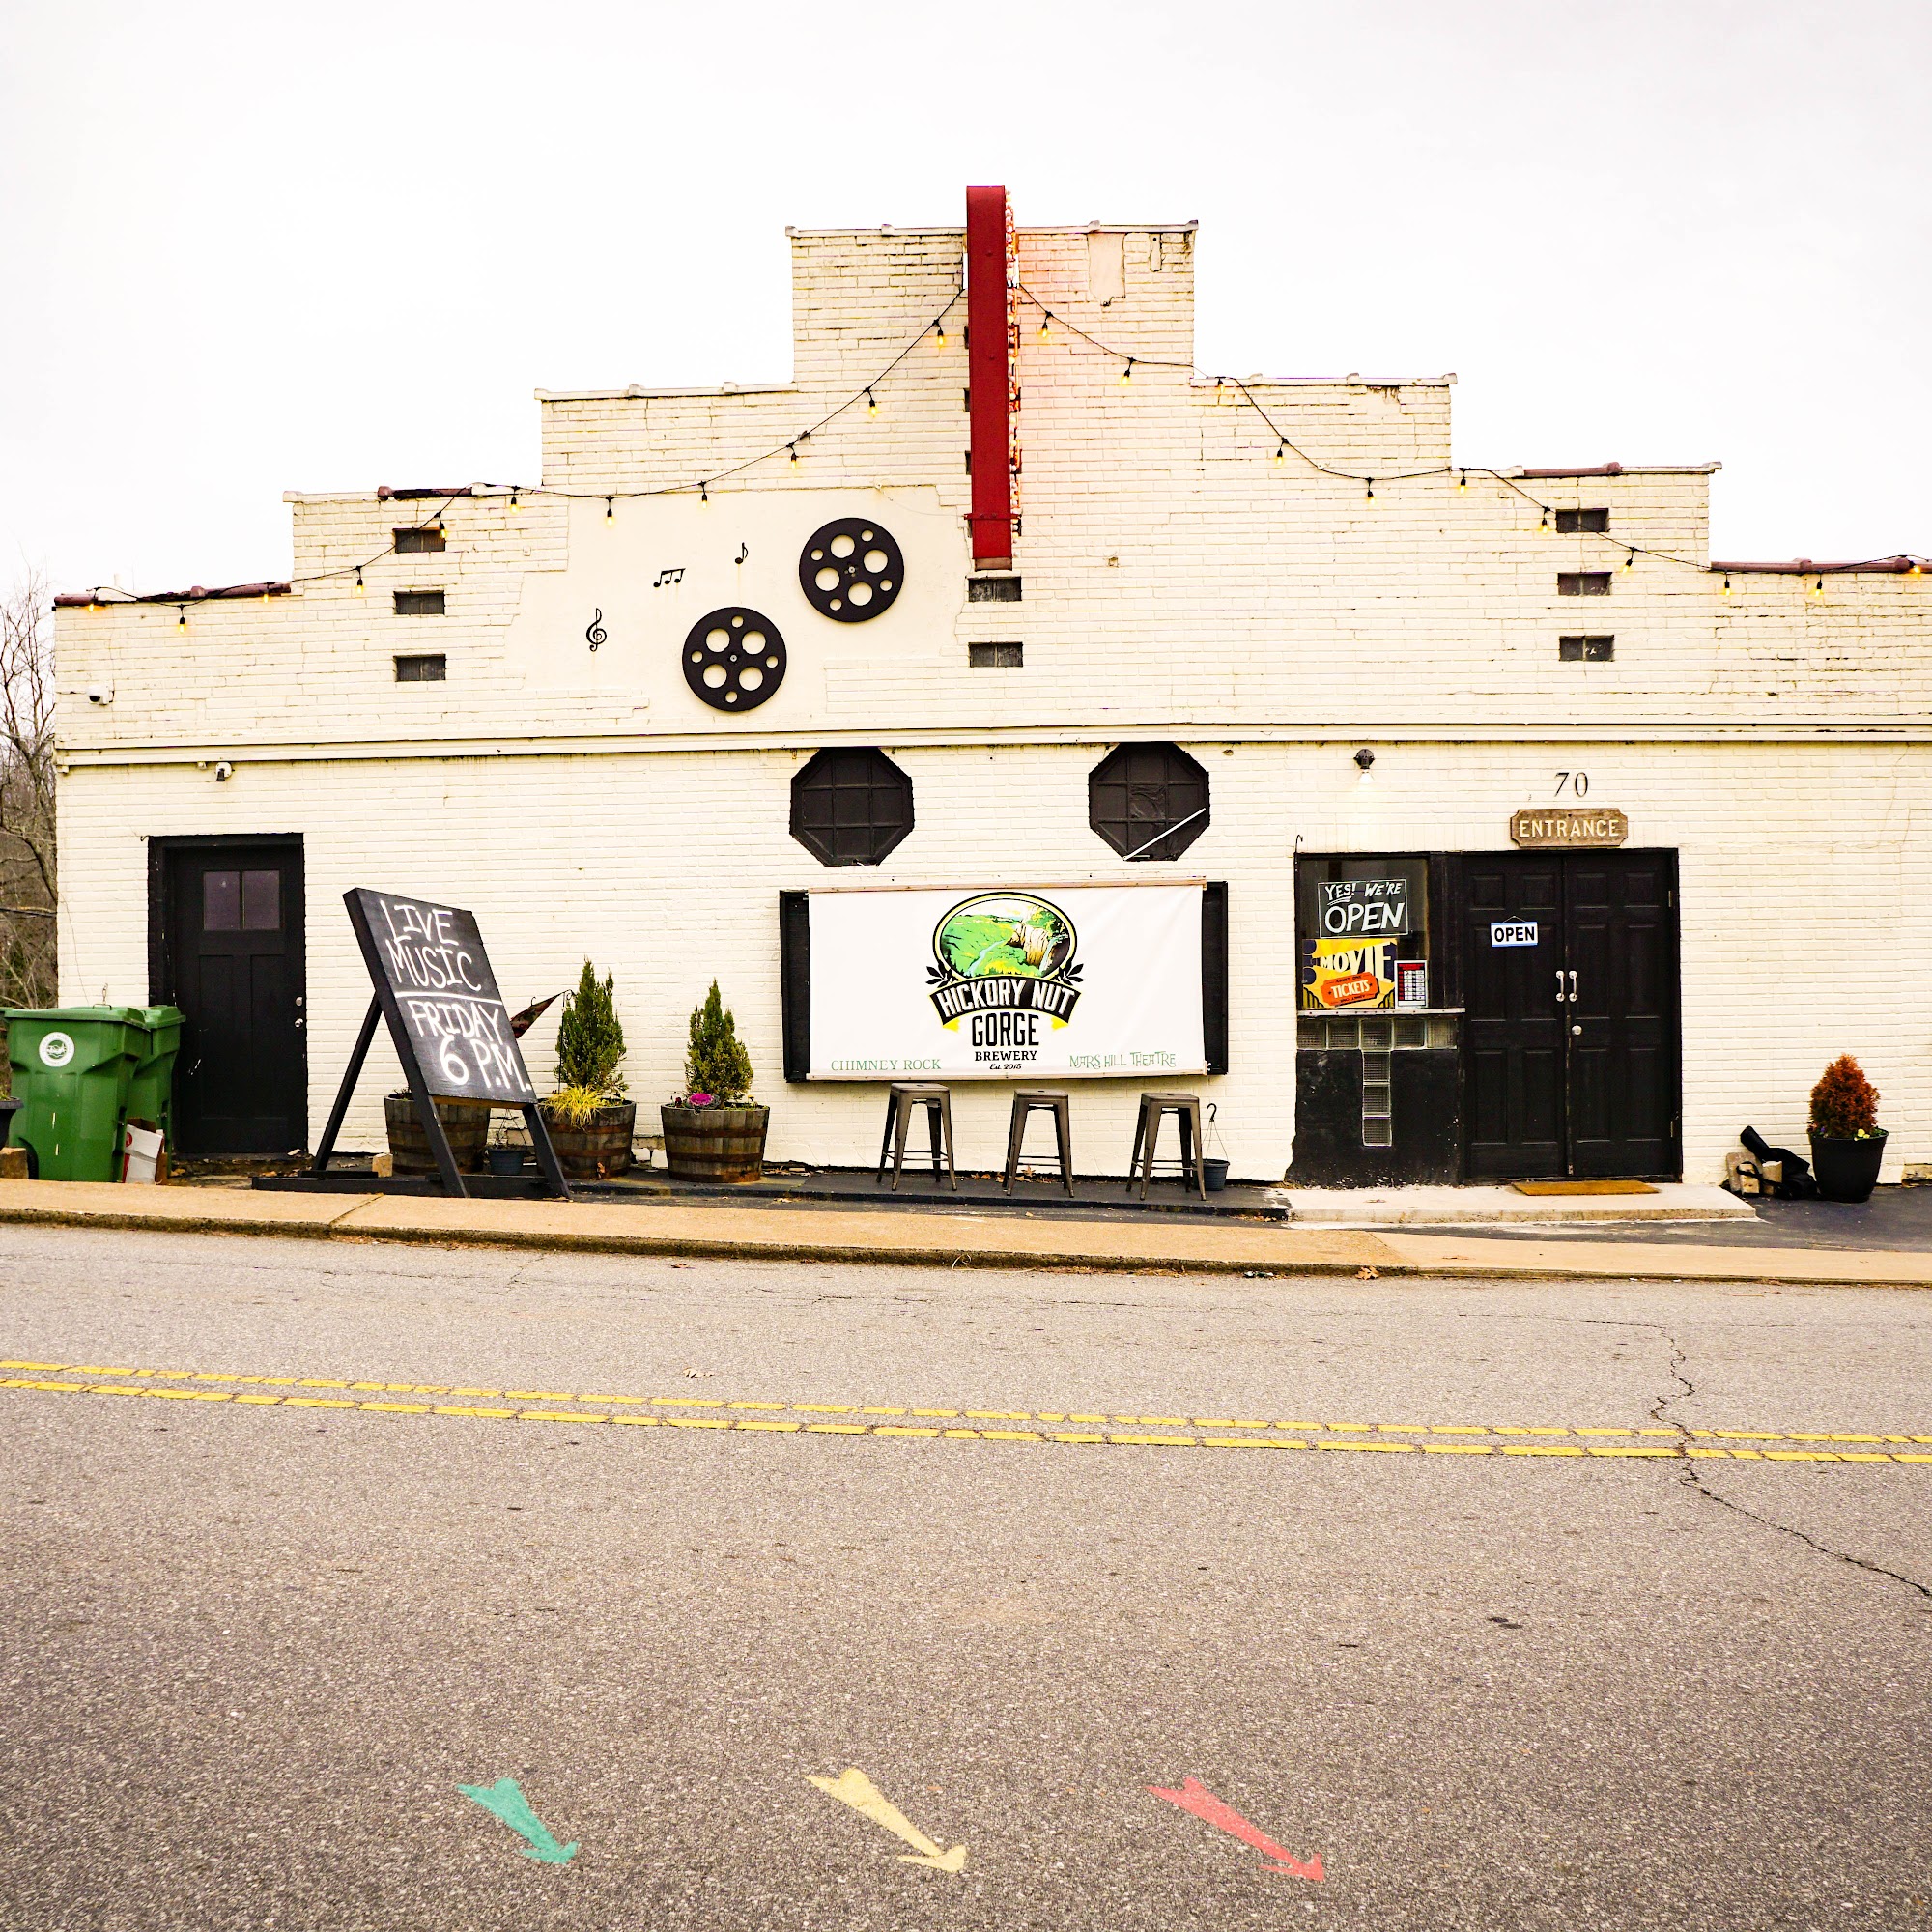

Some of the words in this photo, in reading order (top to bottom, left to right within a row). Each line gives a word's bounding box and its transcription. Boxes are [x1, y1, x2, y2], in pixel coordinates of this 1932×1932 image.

[1553, 772, 1589, 797] 70
[1519, 819, 1620, 838] ENTRANCE
[1324, 882, 1357, 901] YES!
[1364, 881, 1403, 897] WE'RE
[380, 899, 459, 946] LIVE
[1324, 901, 1406, 934] OPEN
[1493, 925, 1535, 943] OPEN
[384, 939, 482, 992] MUSIC
[1320, 941, 1393, 983] MOVIE
[935, 978, 1027, 1018] HICKORY
[1030, 980, 1076, 1015] NUT
[1330, 979, 1371, 999] TICKETS
[407, 999, 503, 1046] FRIDAY
[971, 1011, 1039, 1047] GORGE
[440, 1034, 469, 1086] 6
[469, 1038, 532, 1093] P.M.
[831, 1060, 898, 1071] CHIMNEY
[903, 1059, 942, 1070] ROCK
[975, 1050, 1037, 1062] BREWERY
[1069, 1054, 1101, 1069] MARS
[1104, 1054, 1127, 1067] HILL
[1129, 1050, 1177, 1067] THEATRE
